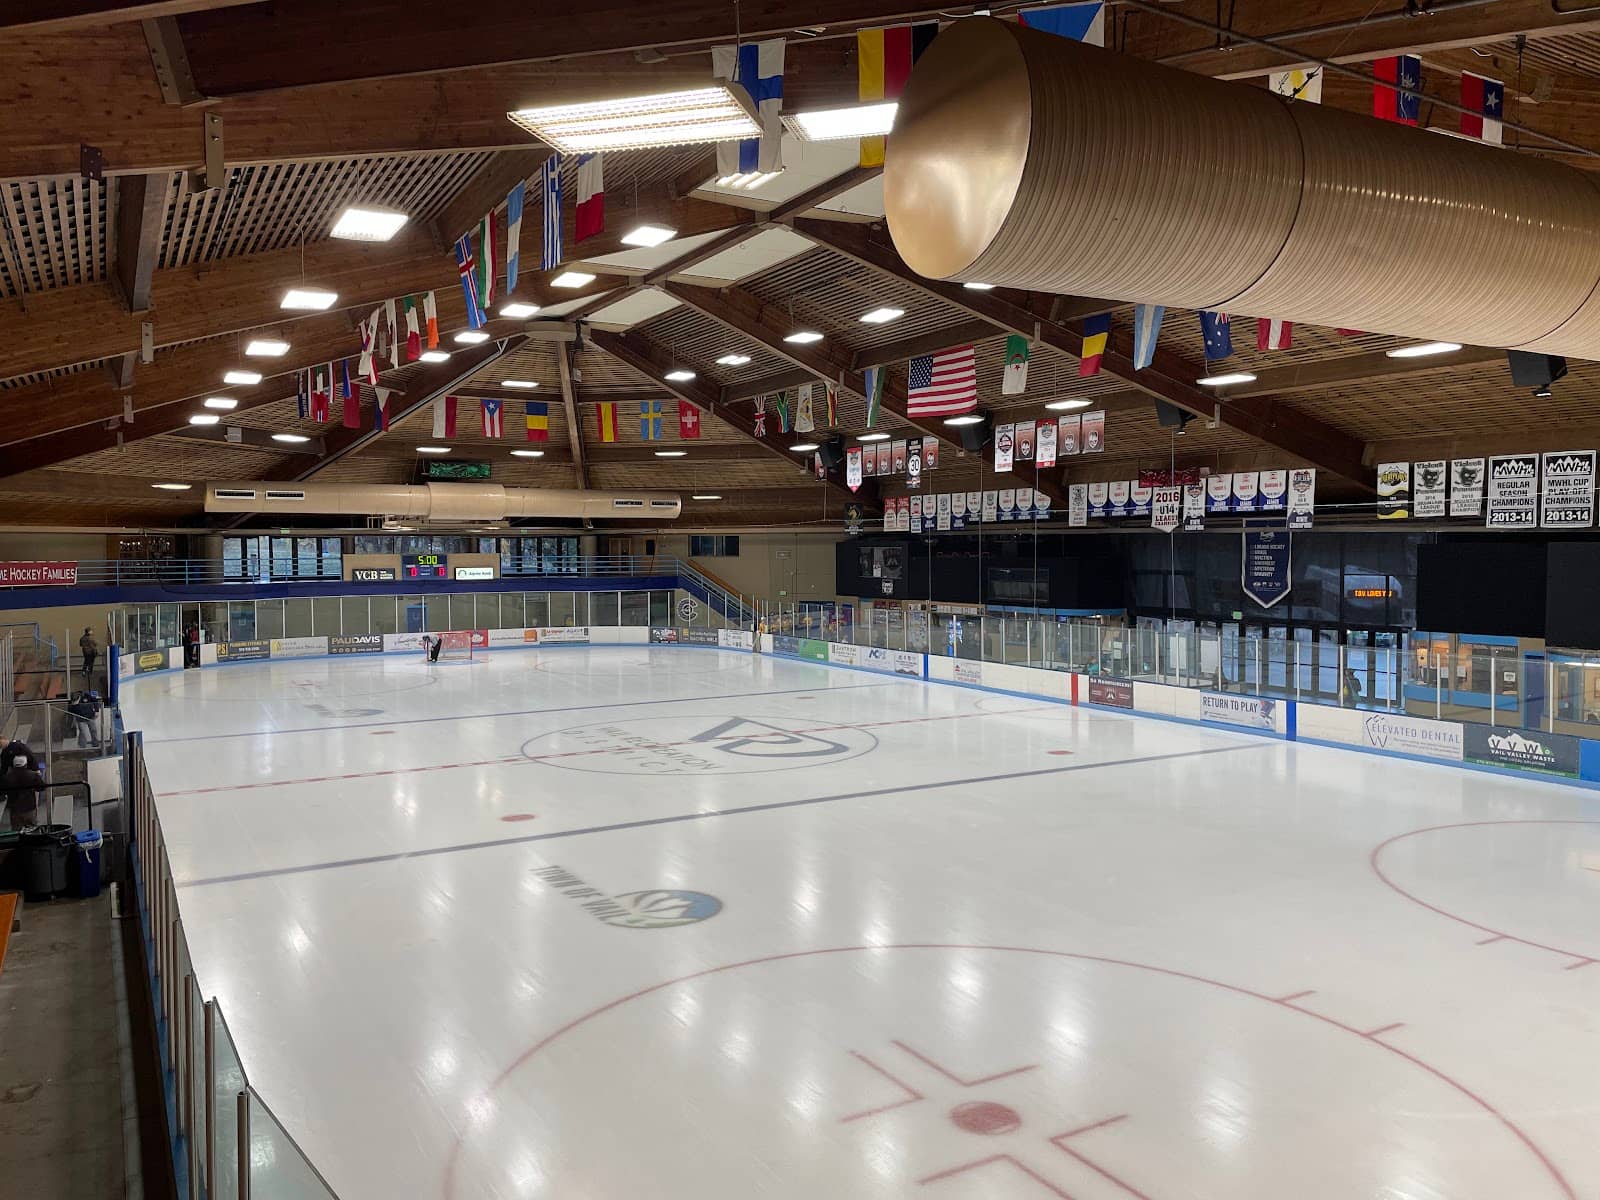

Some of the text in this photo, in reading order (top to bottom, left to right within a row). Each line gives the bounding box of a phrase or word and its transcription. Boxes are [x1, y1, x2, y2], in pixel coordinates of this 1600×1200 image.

[911, 459, 919, 471] 30
[1497, 481, 1530, 489] REGULAR
[1547, 478, 1589, 487] MWHL CUP
[1548, 487, 1589, 496] PLAY-OFF
[1155, 492, 1180, 503] 2016
[1492, 498, 1535, 506] CHAMPIONS
[1545, 497, 1591, 505] CHAMPIONS
[1492, 511, 1532, 522] 2013-14
[1546, 510, 1589, 521] 2013-14
[10, 567, 41, 581] HOCKEY
[42, 566, 75, 580] FAMILIES
[355, 570, 378, 580] VCB
[1202, 696, 1258, 713] RETURN TO PLAY
[1372, 723, 1460, 744] ELEVATED DENTAL
[1506, 751, 1530, 759] VALLEY
[1532, 755, 1556, 763] WASTE
[580, 898, 634, 922] VAIL
